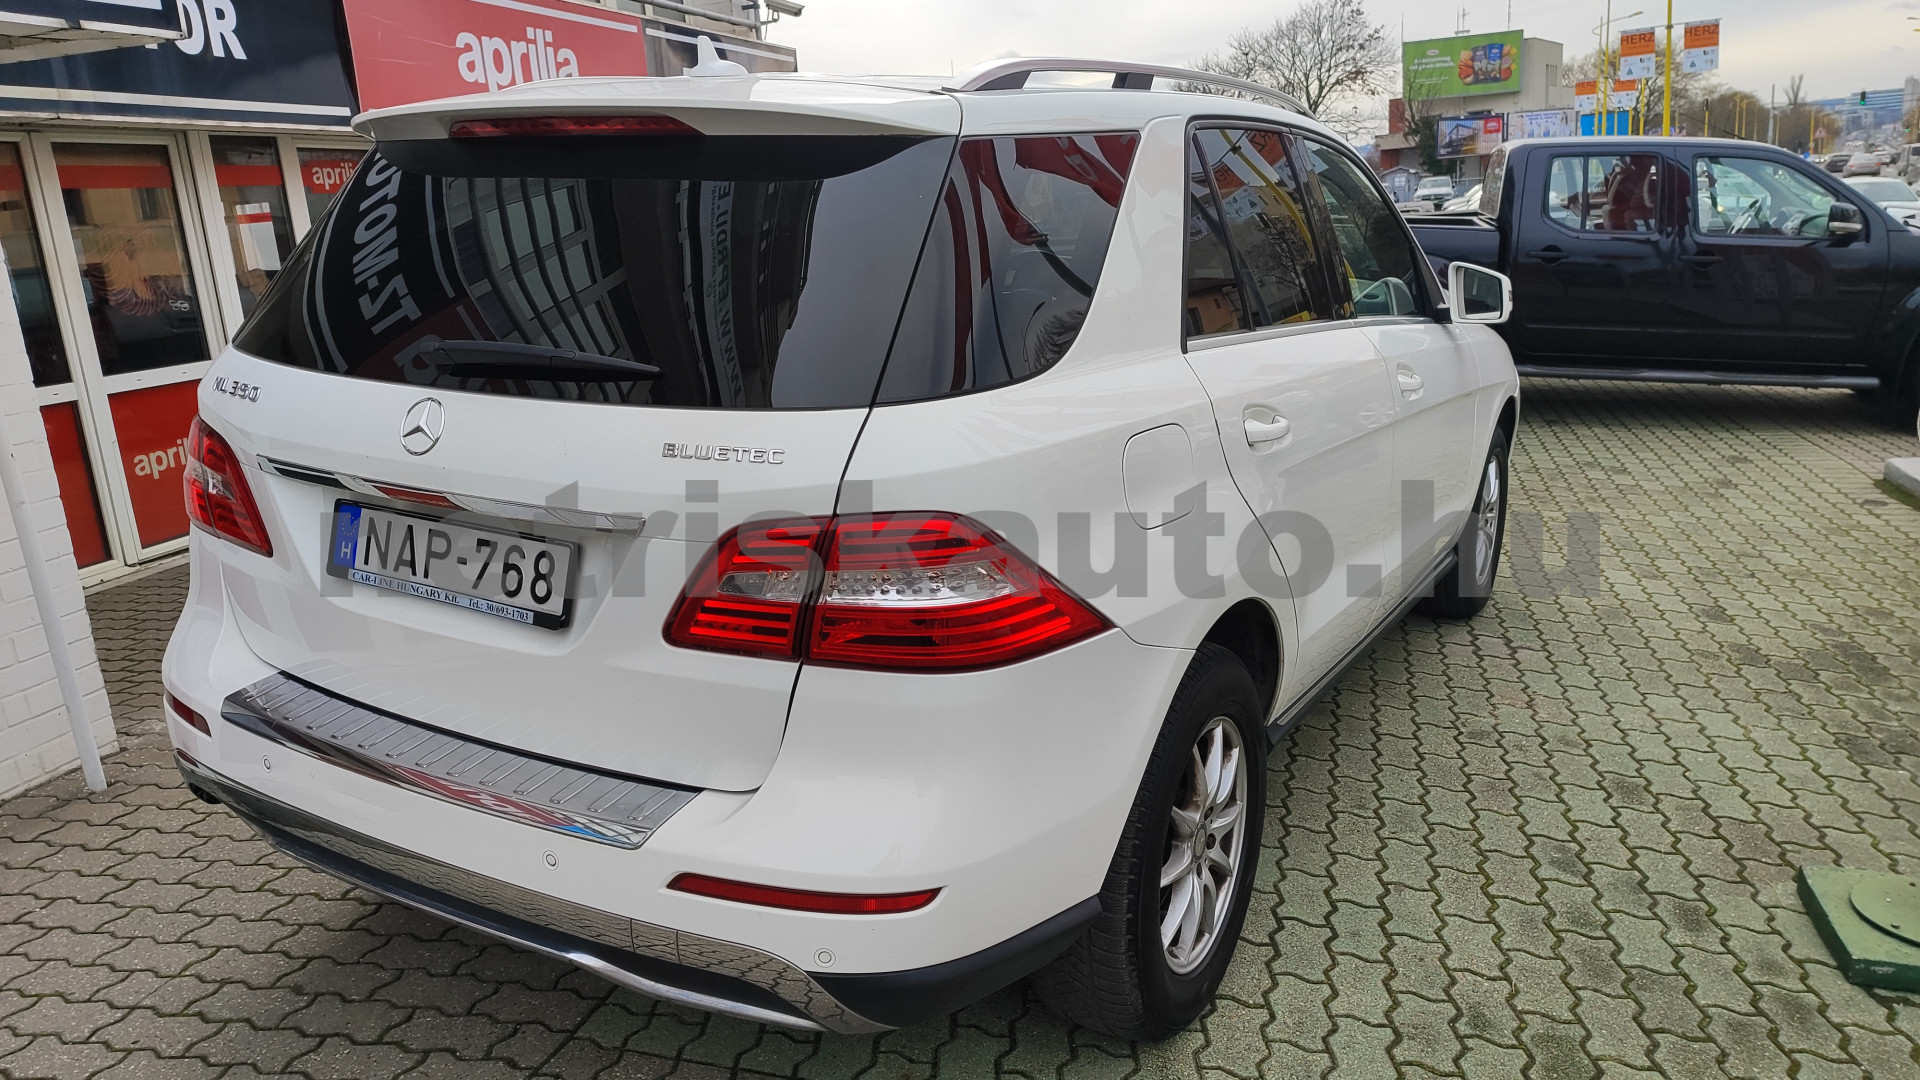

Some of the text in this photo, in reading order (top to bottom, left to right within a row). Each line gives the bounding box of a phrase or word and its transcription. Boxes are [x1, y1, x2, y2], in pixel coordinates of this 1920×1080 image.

[145, 0, 247, 60] OR
[1620, 31, 1655, 45] HERZ
[1684, 23, 1719, 37] HERZ
[455, 26, 580, 93] aprilia
[311, 162, 356, 191] aprili
[133, 437, 188, 480] april
[661, 442, 786, 465] BLUETEC
[340, 541, 352, 560] H
[363, 516, 556, 605] NAP-768
[352, 571, 530, 622] CAR-LINE HUNGARY Kft. Tel.: 30/693-1703
